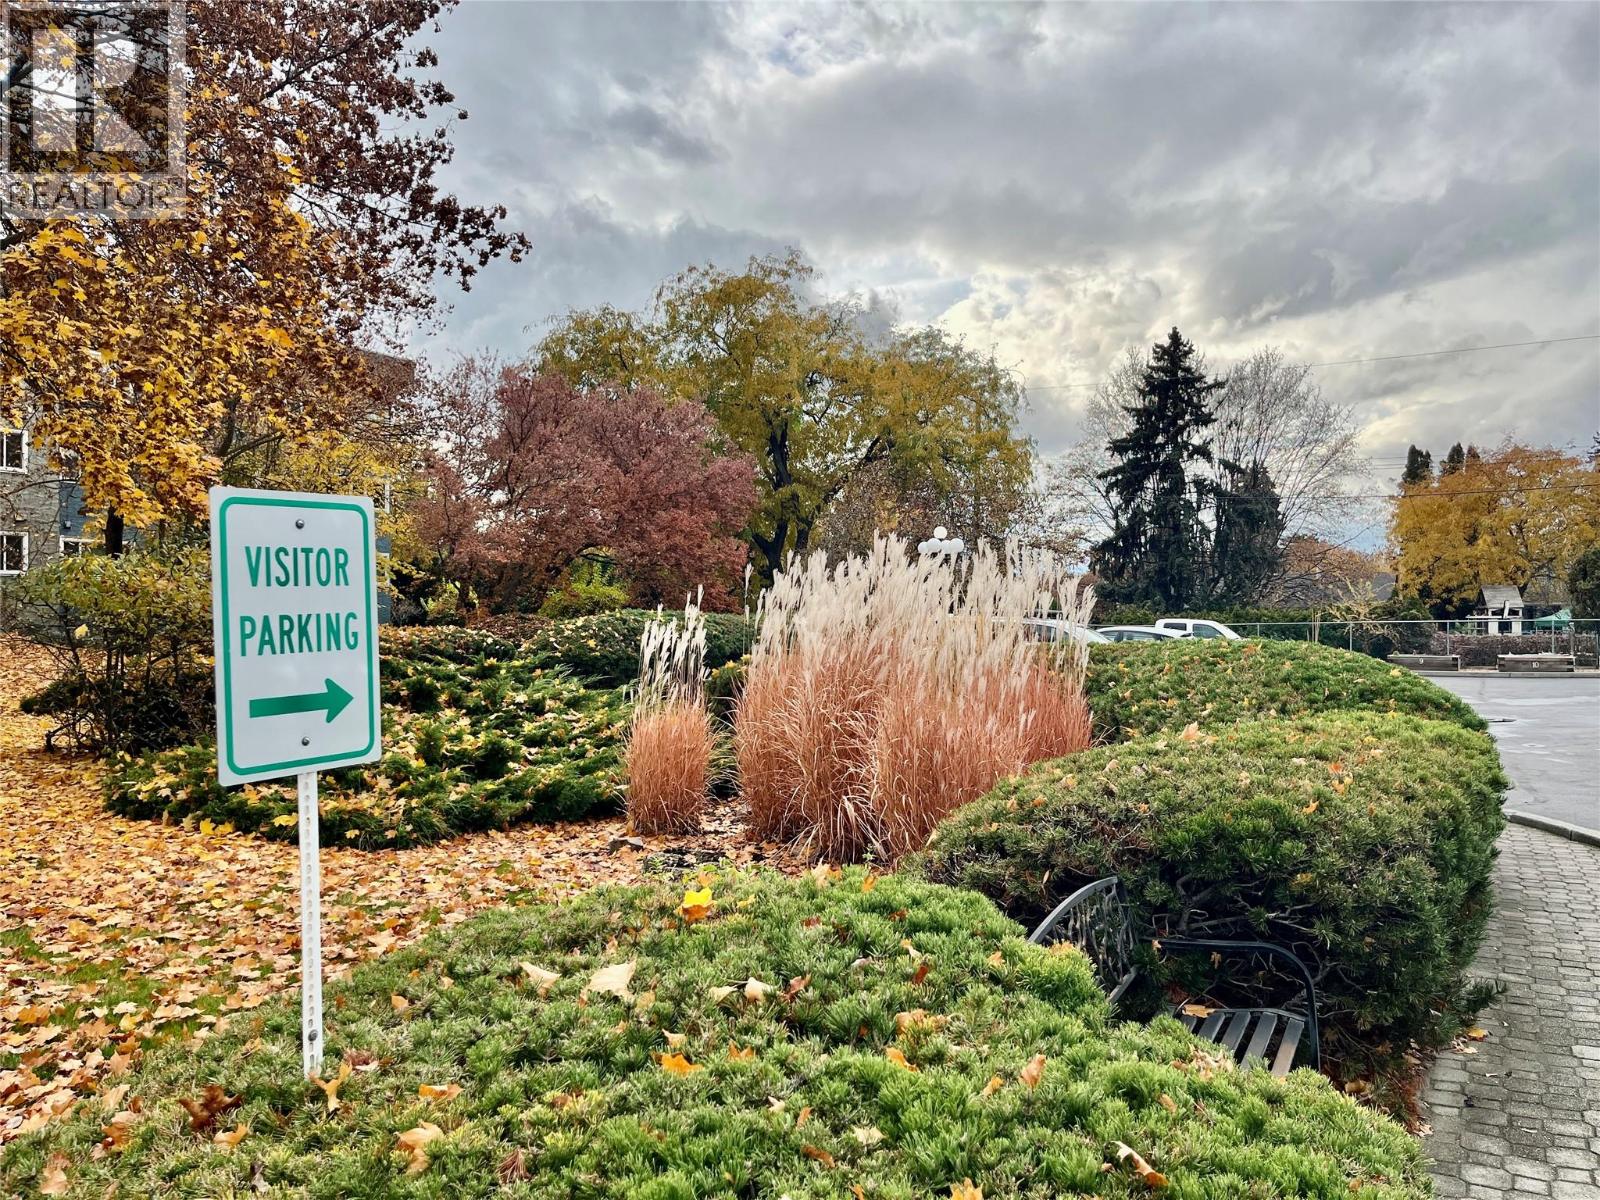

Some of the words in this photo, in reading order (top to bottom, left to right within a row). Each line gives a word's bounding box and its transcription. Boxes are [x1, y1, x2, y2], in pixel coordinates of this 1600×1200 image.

[245, 546, 349, 587] VISITOR
[240, 612, 358, 656] PARKING
[1532, 661, 1540, 669] 10
